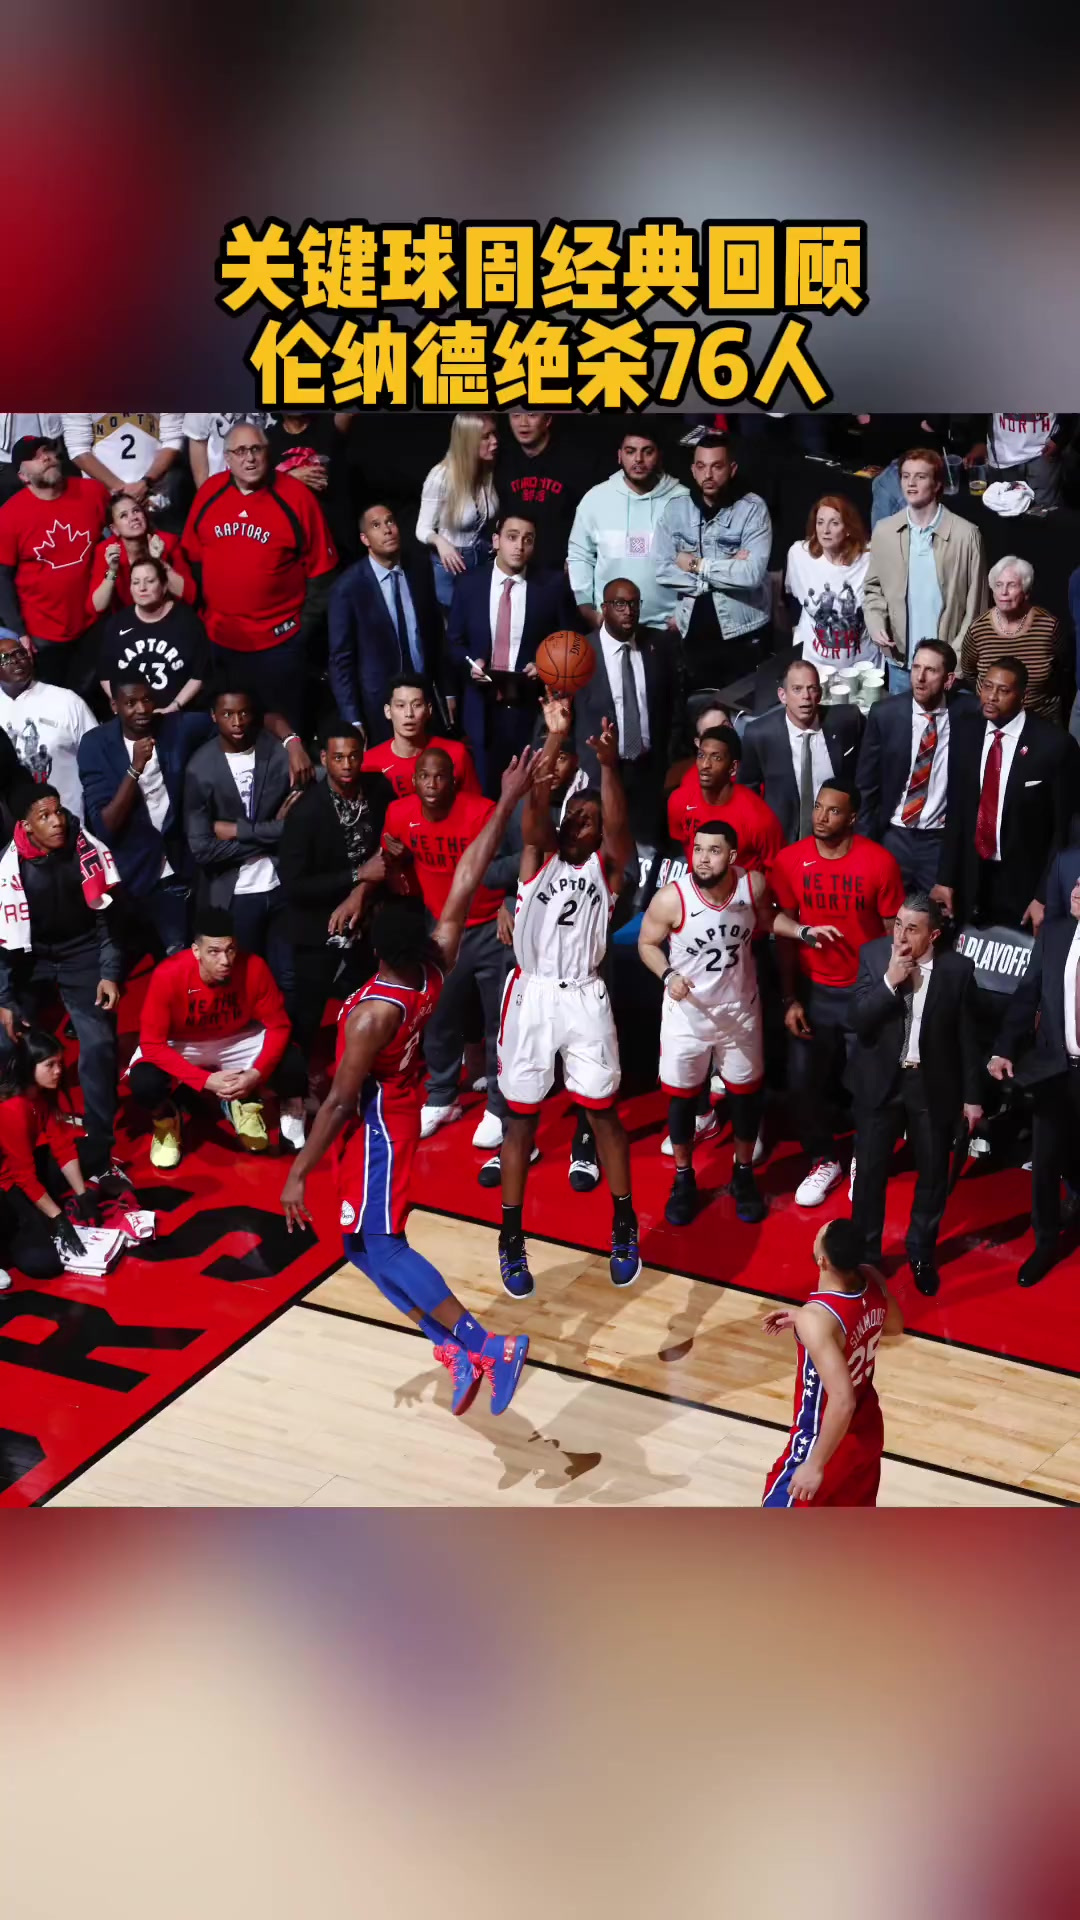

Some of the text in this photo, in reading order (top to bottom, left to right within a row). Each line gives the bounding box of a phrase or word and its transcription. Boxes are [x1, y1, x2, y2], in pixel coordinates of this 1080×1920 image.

[1000, 414, 1050, 433] NORTH
[120, 433, 136, 460] 2
[214, 522, 271, 544] RAPTORS
[537, 877, 601, 905] RAPTORS
[803, 873, 864, 893] WE THE
[557, 900, 577, 926] 2
[803, 893, 865, 912] NORTH
[705, 943, 740, 972] 23
[848, 1327, 882, 1387] 25
